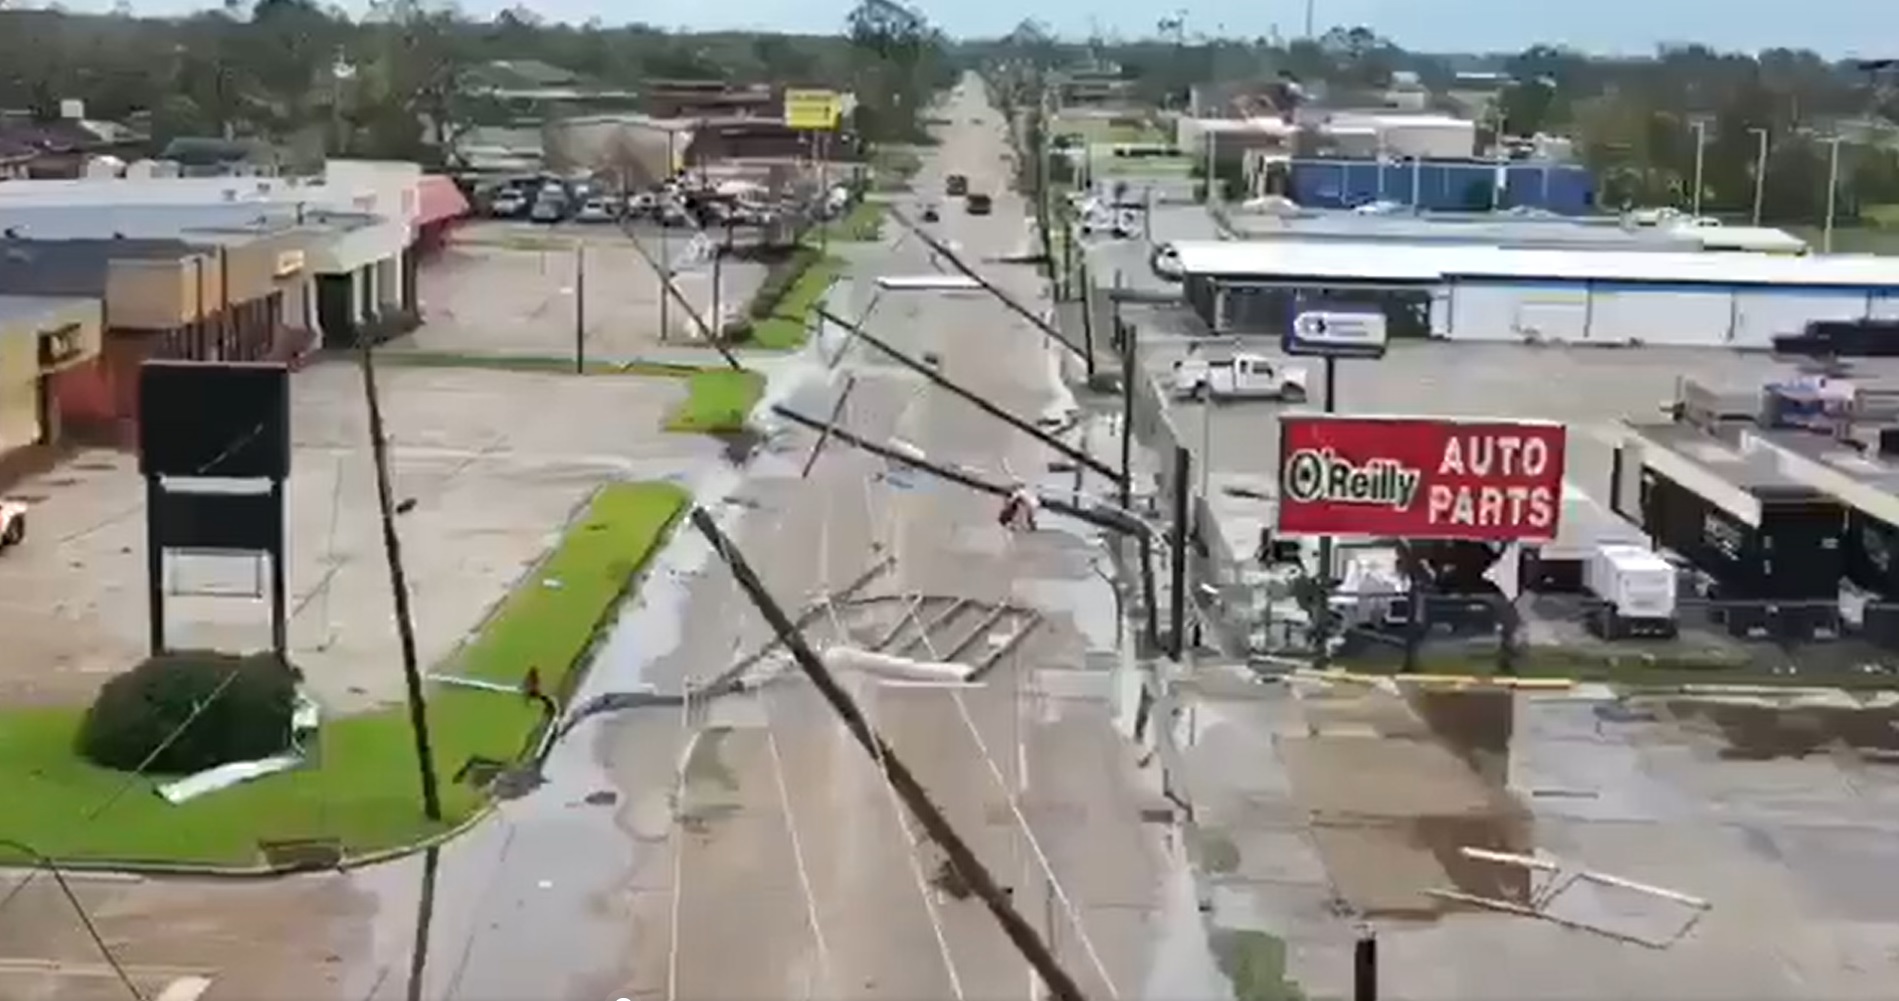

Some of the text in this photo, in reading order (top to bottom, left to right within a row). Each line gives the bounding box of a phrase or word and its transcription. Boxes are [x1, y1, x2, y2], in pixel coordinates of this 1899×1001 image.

[1438, 436, 1547, 477] AUTO
[1287, 448, 1420, 511] O'Reilly
[1428, 486, 1553, 528] PARTS
